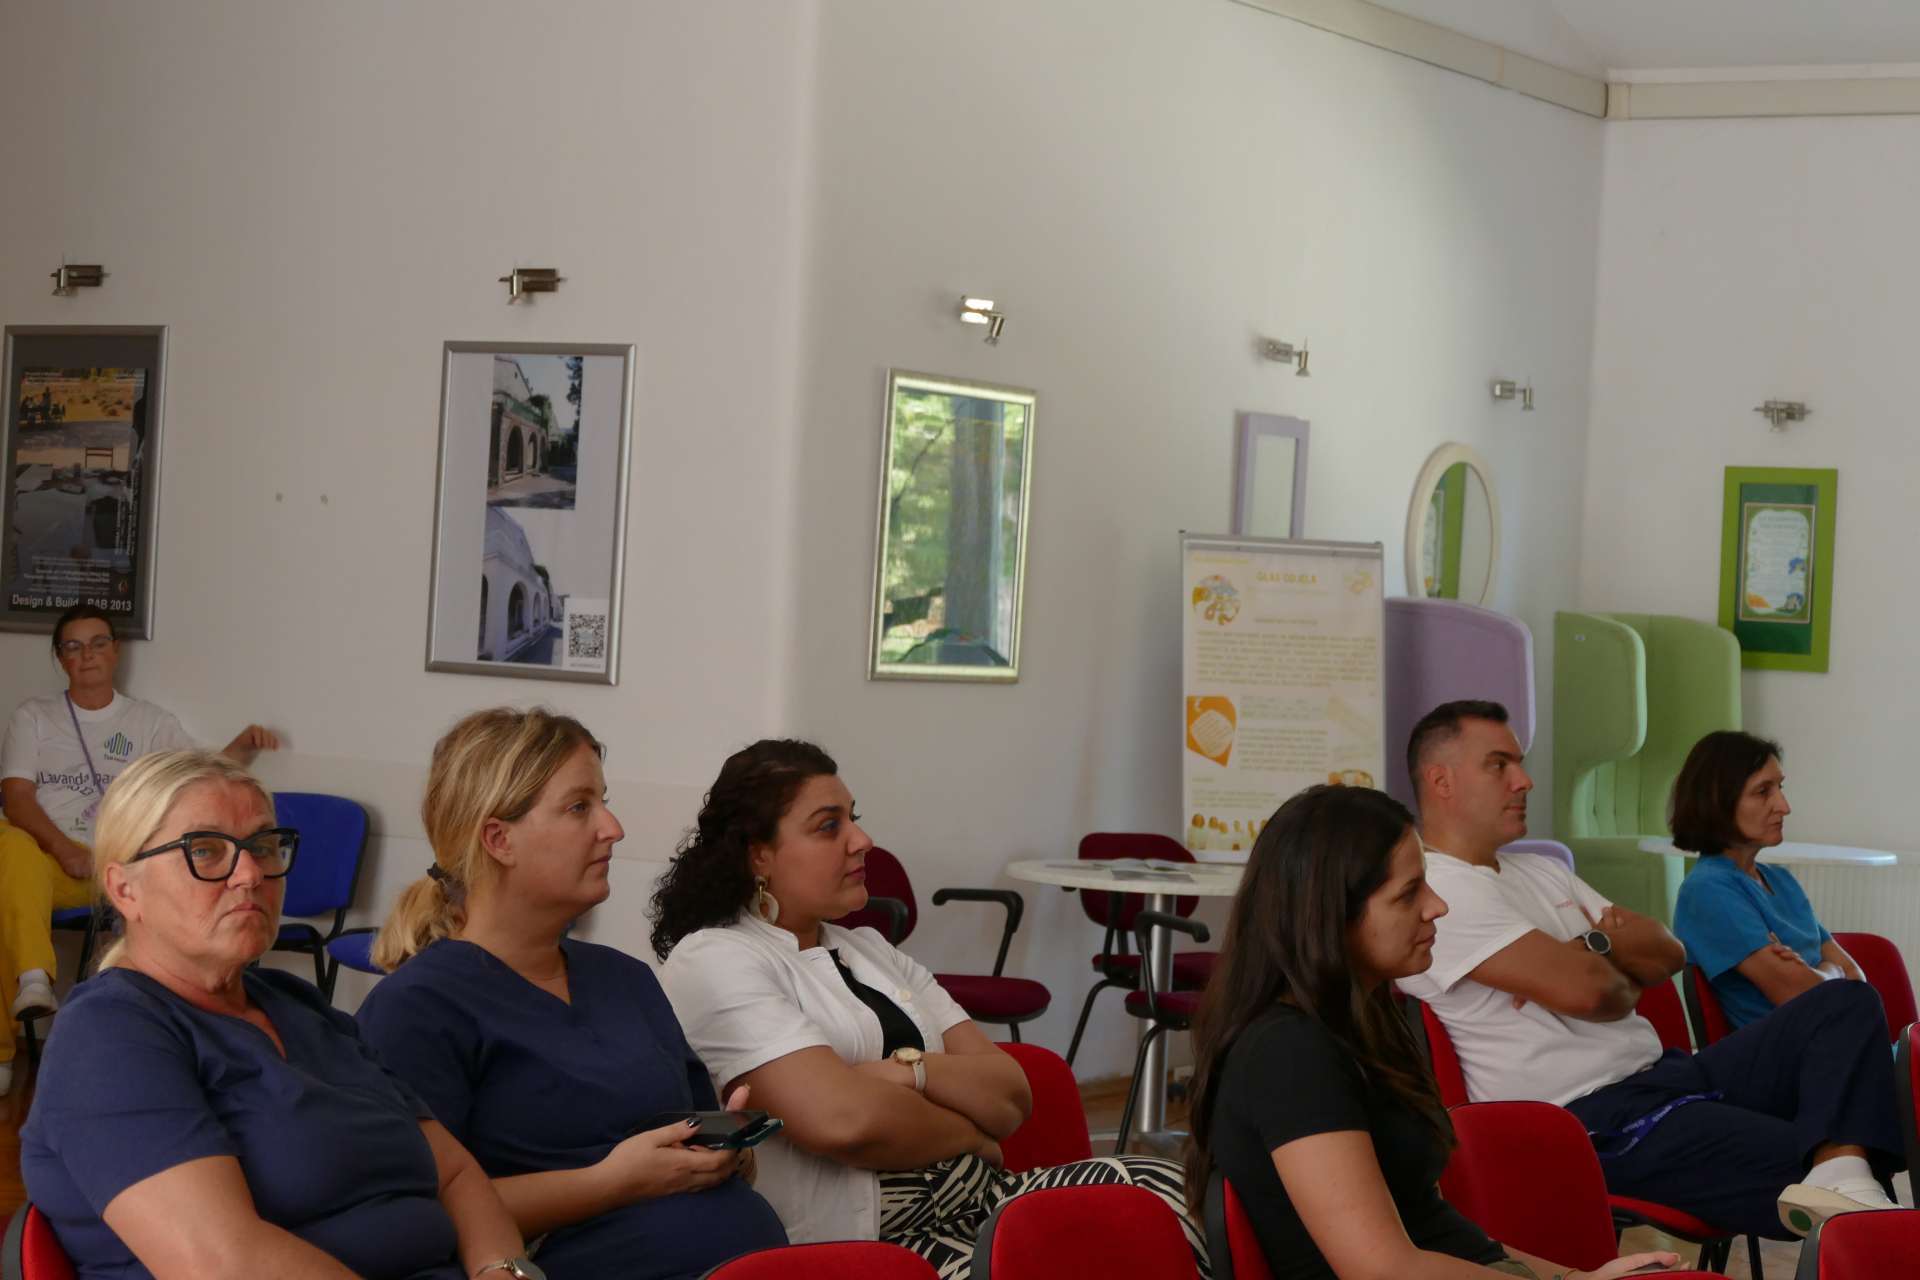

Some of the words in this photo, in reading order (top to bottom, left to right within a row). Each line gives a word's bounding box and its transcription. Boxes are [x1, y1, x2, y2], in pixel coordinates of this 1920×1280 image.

[12, 594, 43, 608] Design
[45, 595, 53, 607] &
[55, 596, 79, 608] Build
[110, 599, 132, 611] 2013
